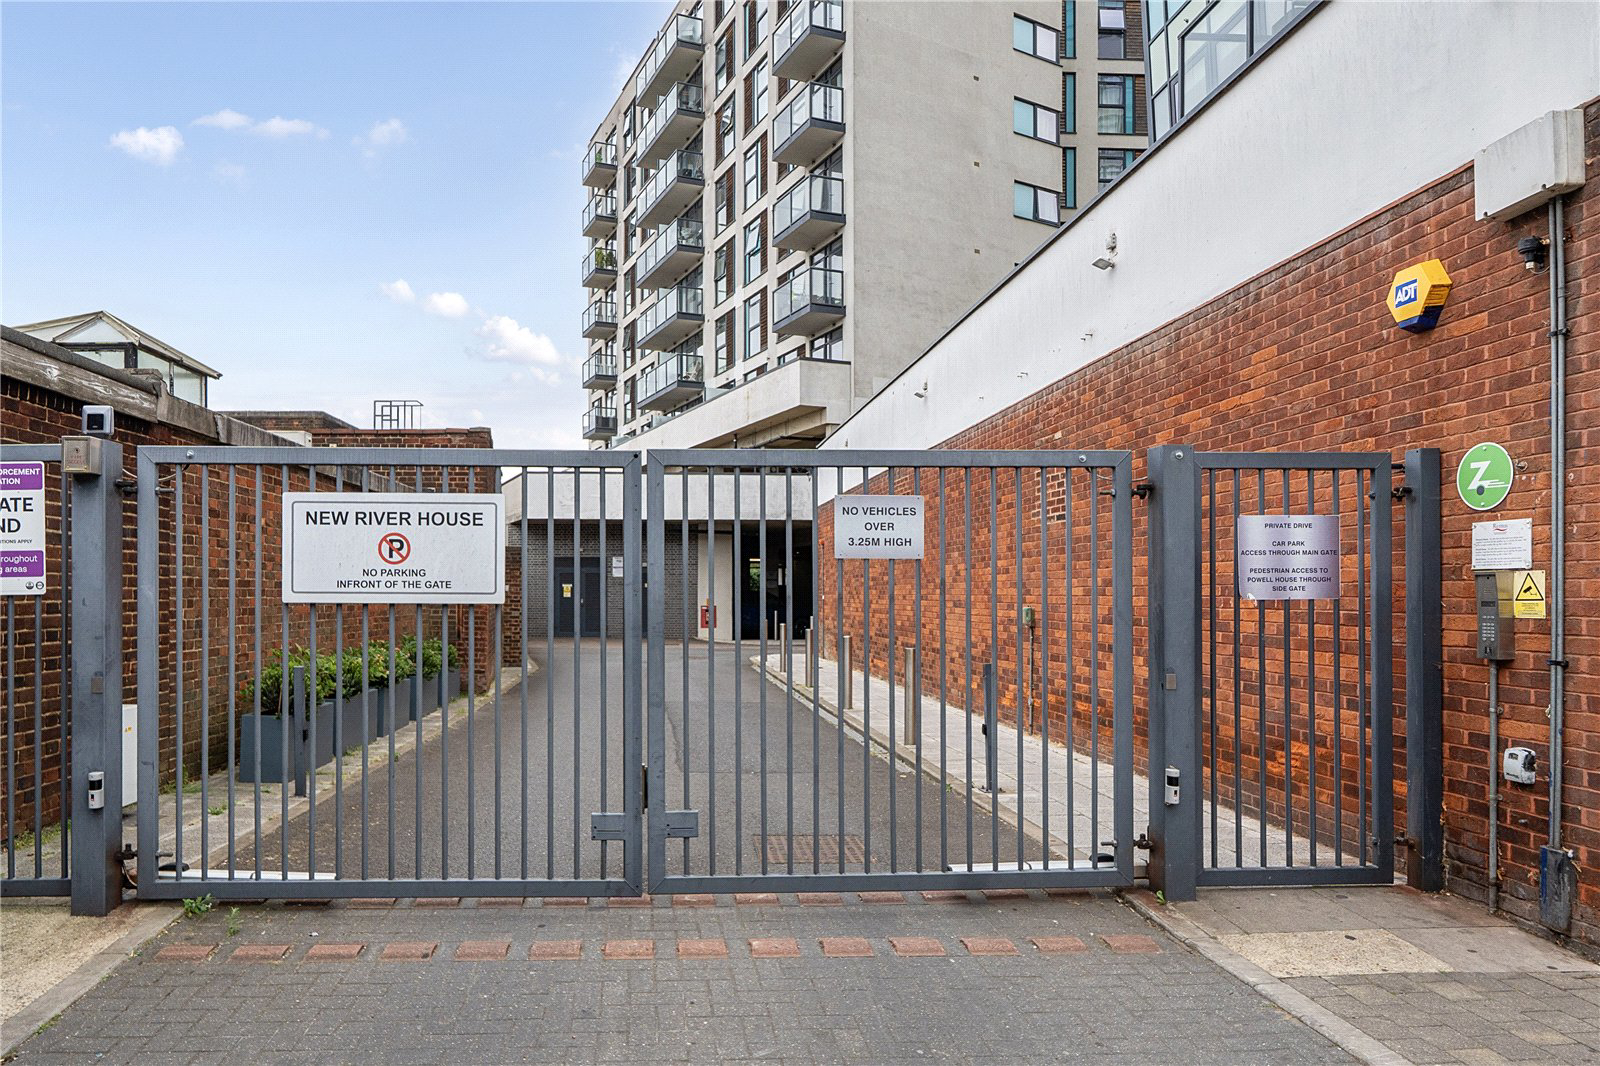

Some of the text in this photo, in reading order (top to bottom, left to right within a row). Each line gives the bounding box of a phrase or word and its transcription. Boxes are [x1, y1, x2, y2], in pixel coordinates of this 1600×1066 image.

[1396, 282, 1418, 305] ADT
[842, 506, 917, 516] NO VEHICLES
[305, 511, 484, 526] NEW RIVER HOUSE
[864, 522, 895, 531] OVER
[848, 537, 912, 547] 3.25M HIGH
[362, 568, 426, 577] NO PARKING
[336, 580, 452, 589] INFRONT OF THE GATE
